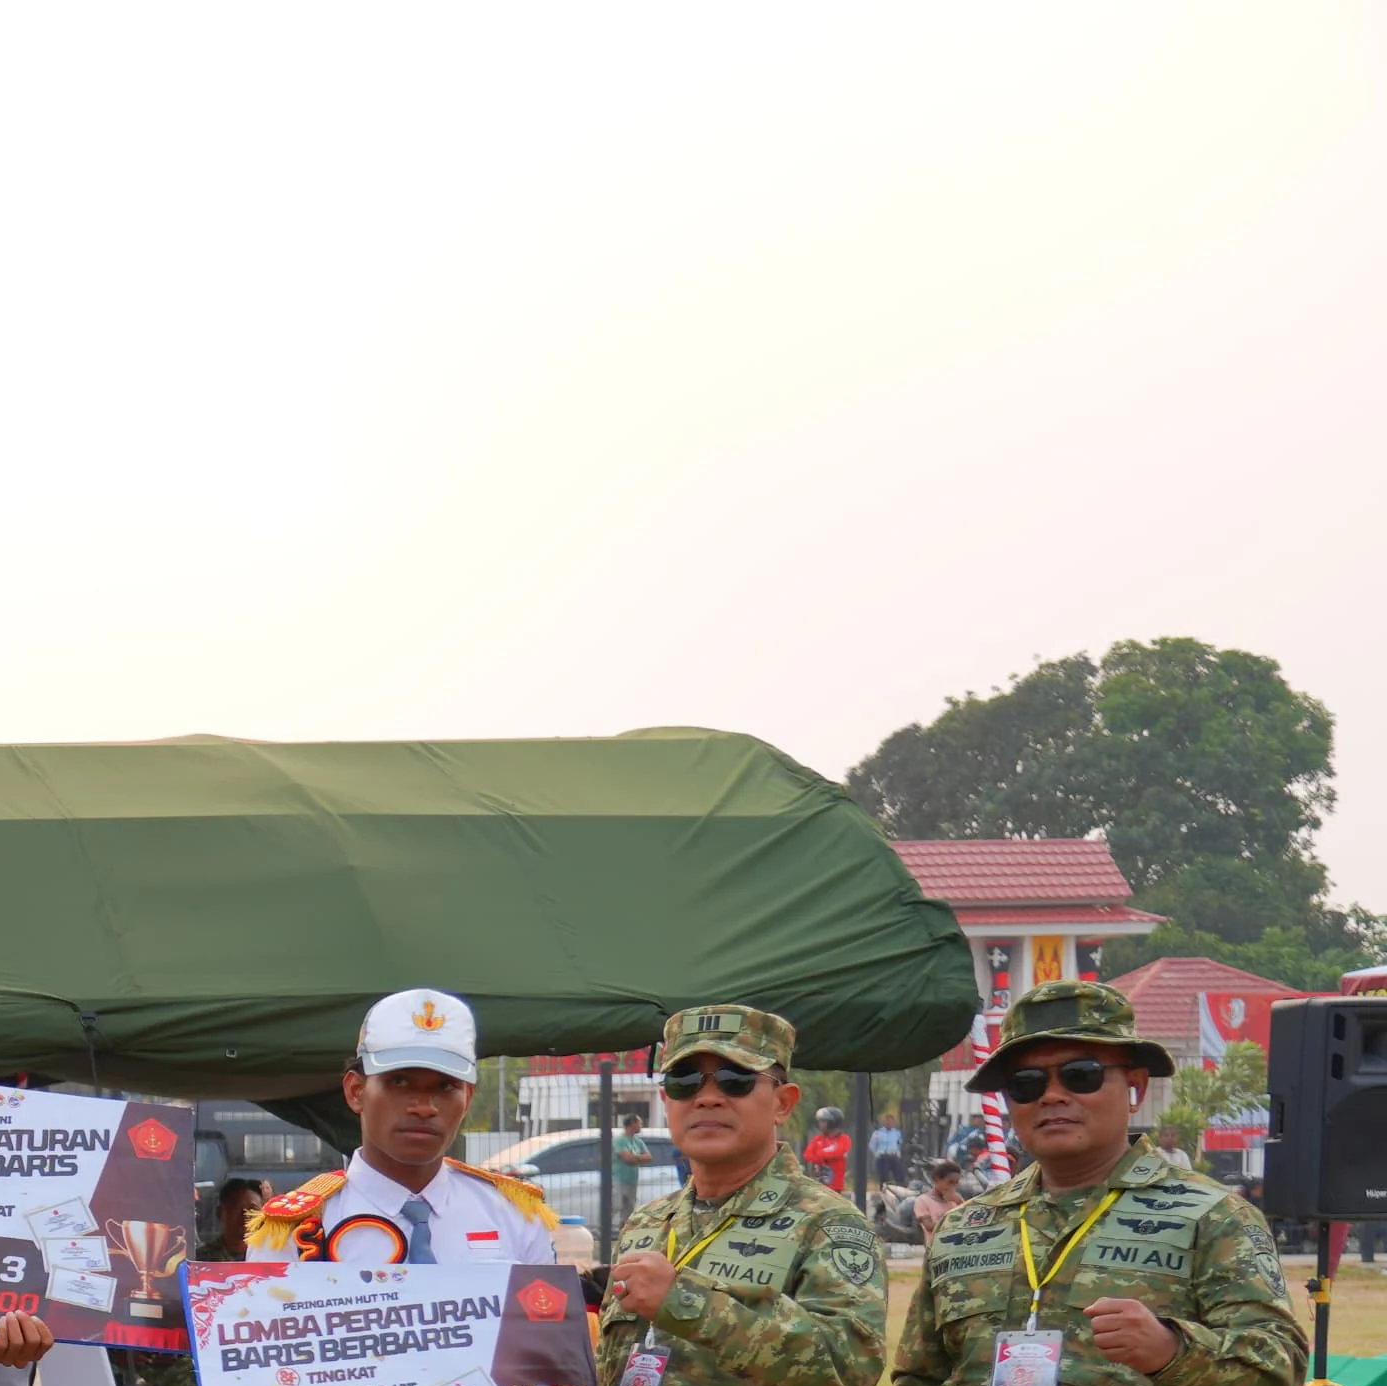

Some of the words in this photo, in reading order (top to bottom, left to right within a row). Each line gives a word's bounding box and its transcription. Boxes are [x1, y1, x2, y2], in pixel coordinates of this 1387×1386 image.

[0, 1255, 27, 1283] 3
[1096, 1244, 1139, 1263] TNI
[1142, 1250, 1184, 1270] AU
[709, 1261, 740, 1279] TNI
[739, 1267, 773, 1285] AU
[282, 1296, 353, 1312] PERINGATAN
[355, 1293, 378, 1305] HUT
[379, 1291, 399, 1302] TNI
[217, 1315, 322, 1346] LOMBA
[325, 1295, 502, 1335] PERATURAN
[221, 1341, 315, 1372] BARIS
[319, 1324, 473, 1363] BERBARIS
[307, 1366, 376, 1384] TINGKAT
